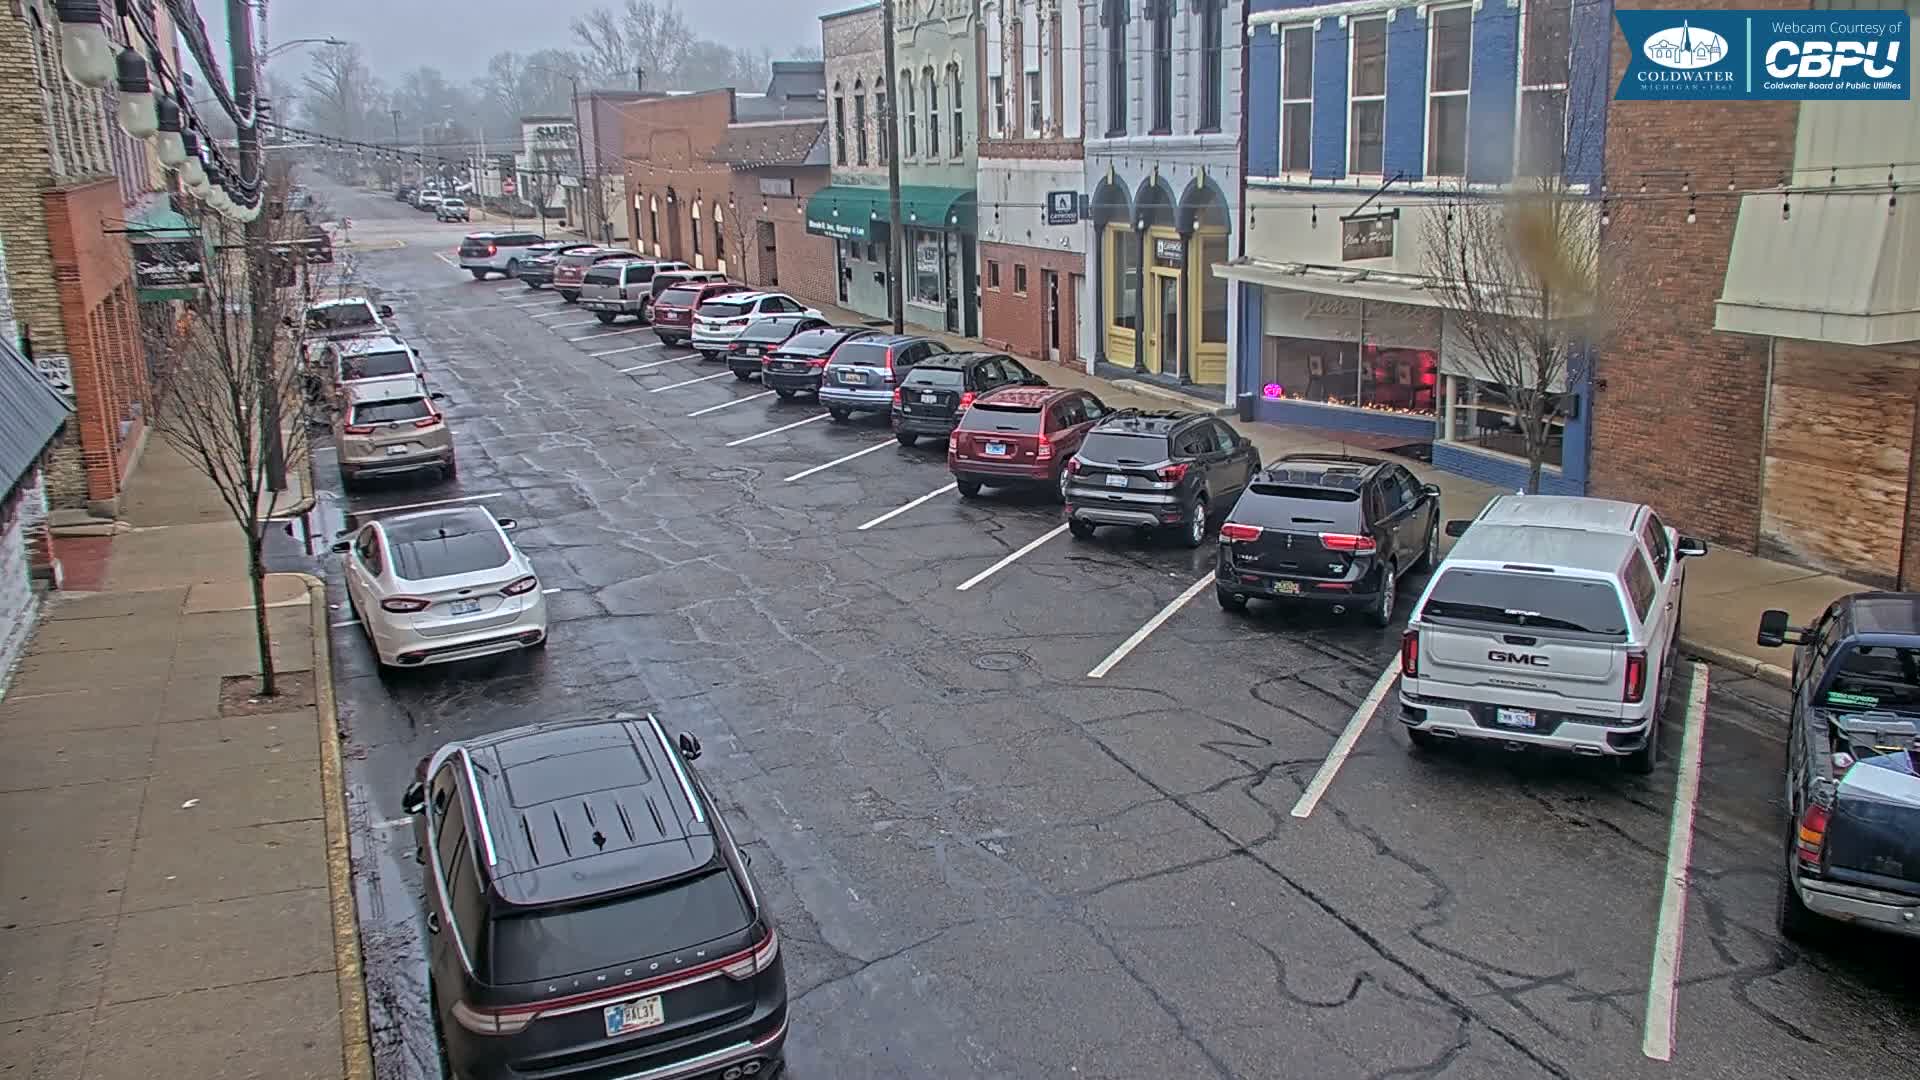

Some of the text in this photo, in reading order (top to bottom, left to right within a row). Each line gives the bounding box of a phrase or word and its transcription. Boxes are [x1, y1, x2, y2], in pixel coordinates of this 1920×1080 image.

[40, 360, 66, 369] ONE
[1487, 650, 1550, 667] GMC
[548, 950, 706, 993] LINCOLN
